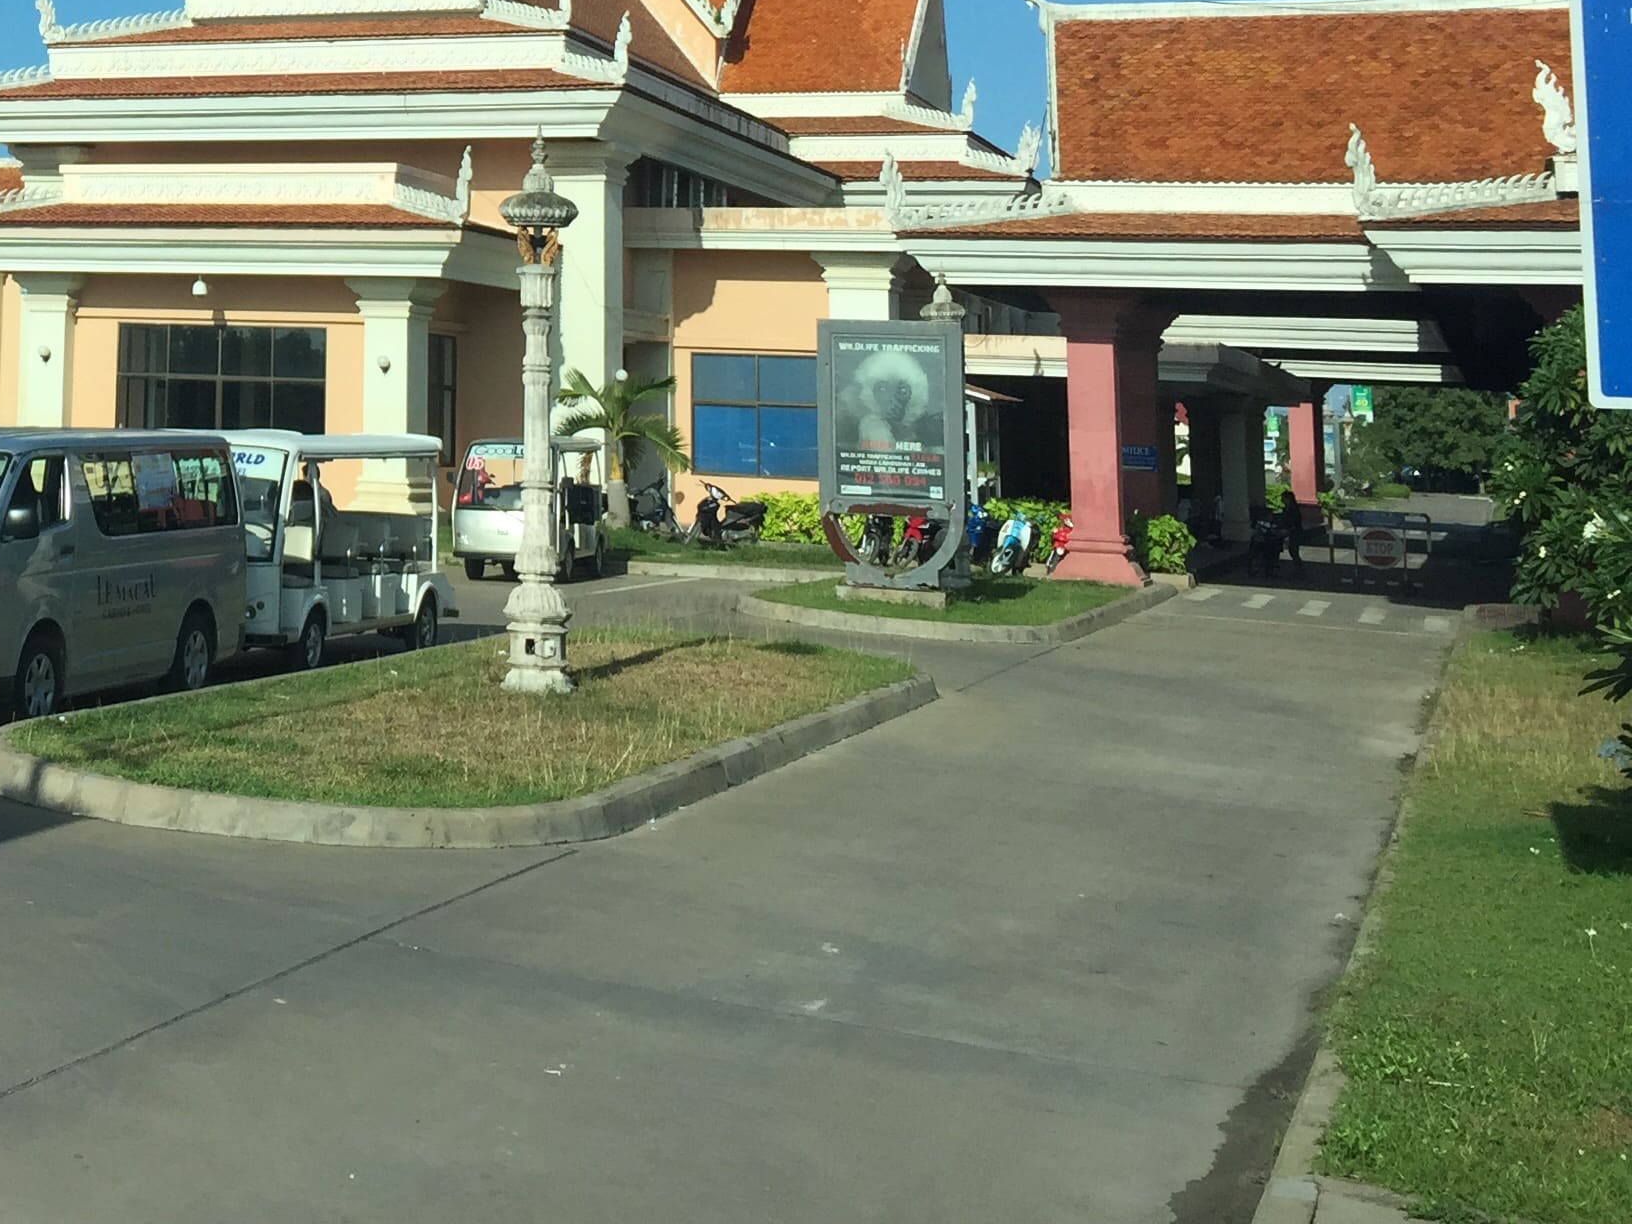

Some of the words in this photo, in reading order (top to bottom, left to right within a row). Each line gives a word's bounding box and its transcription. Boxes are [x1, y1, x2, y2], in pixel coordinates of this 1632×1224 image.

[839, 343, 879, 351] WILDLIFE
[882, 344, 940, 353] TRAFFICKING
[895, 442, 921, 451] HERE
[232, 452, 265, 465] RLD
[840, 464, 872, 472] REPORT
[873, 466, 909, 474] WILDLIFE
[911, 468, 941, 476] CRIMES
